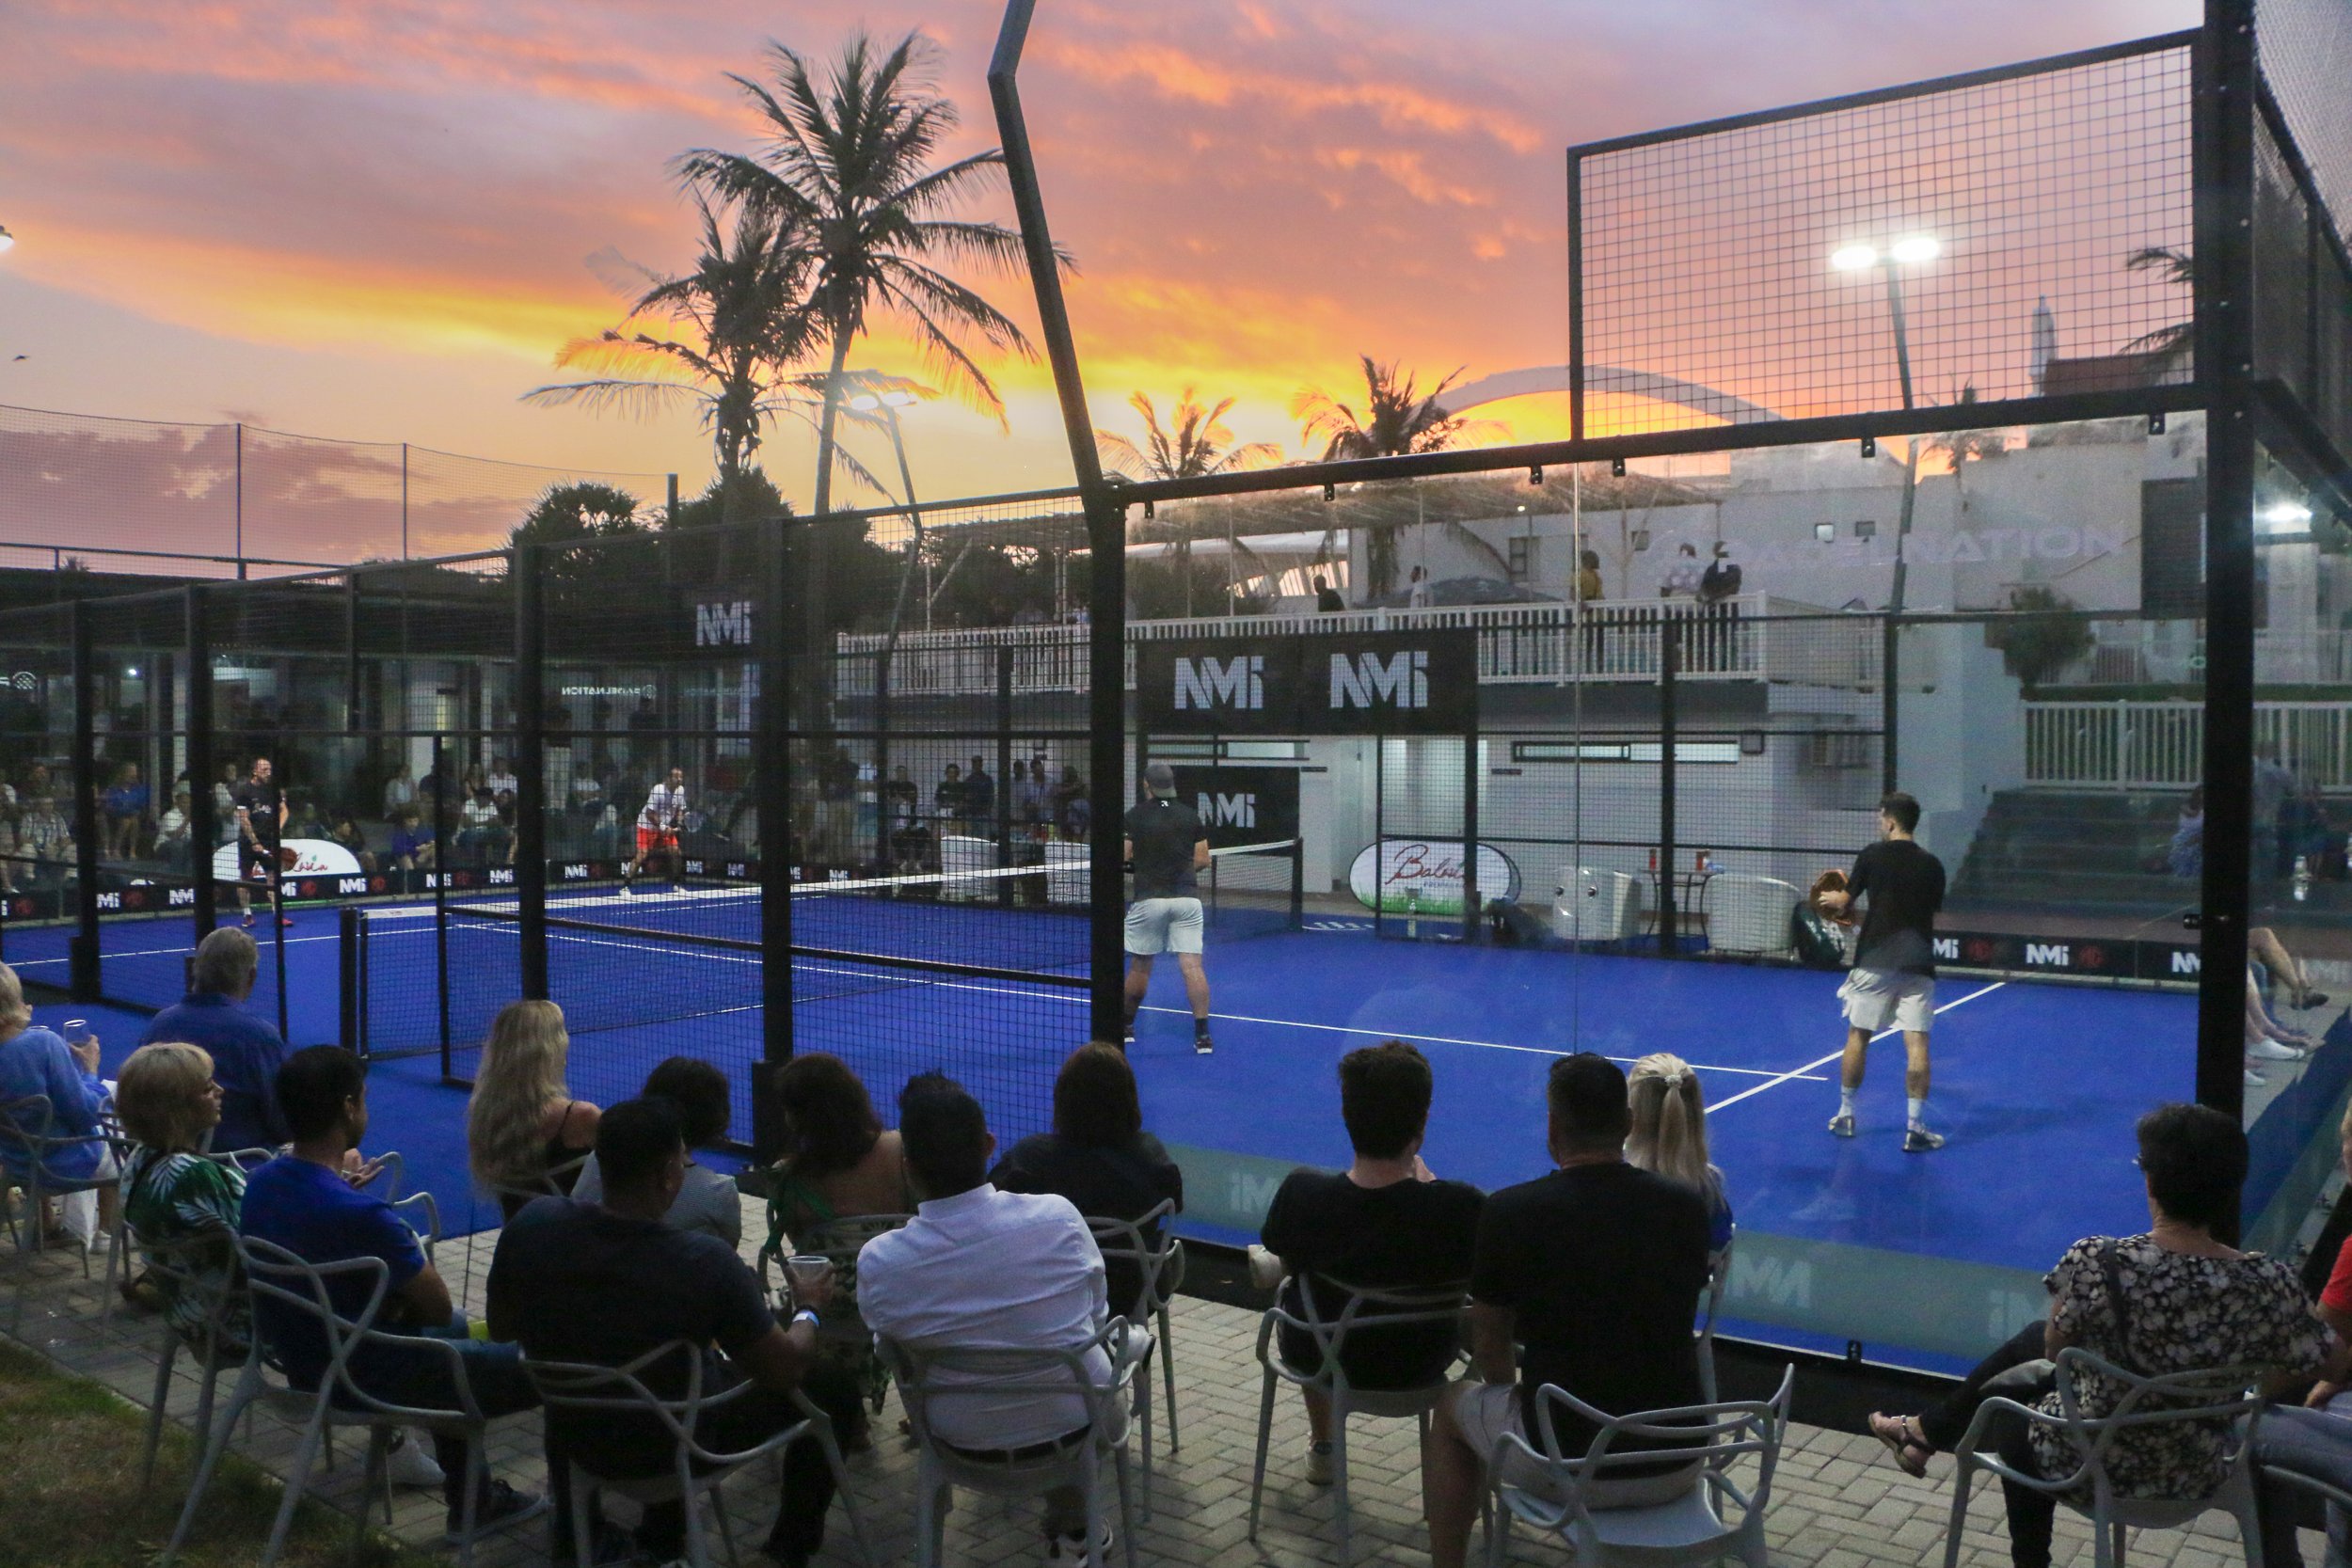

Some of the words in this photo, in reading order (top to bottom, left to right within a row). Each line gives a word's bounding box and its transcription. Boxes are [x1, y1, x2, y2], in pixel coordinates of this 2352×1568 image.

[696, 602, 751, 646] NMi
[1174, 656, 1263, 708] NMi
[1330, 651, 1428, 708] NMi
[1198, 792, 1255, 828] NMi
[339, 878, 367, 894] NMi
[97, 893, 119, 909] Mi
[1933, 938, 1959, 959] Mi
[2026, 943, 2069, 966] NMi
